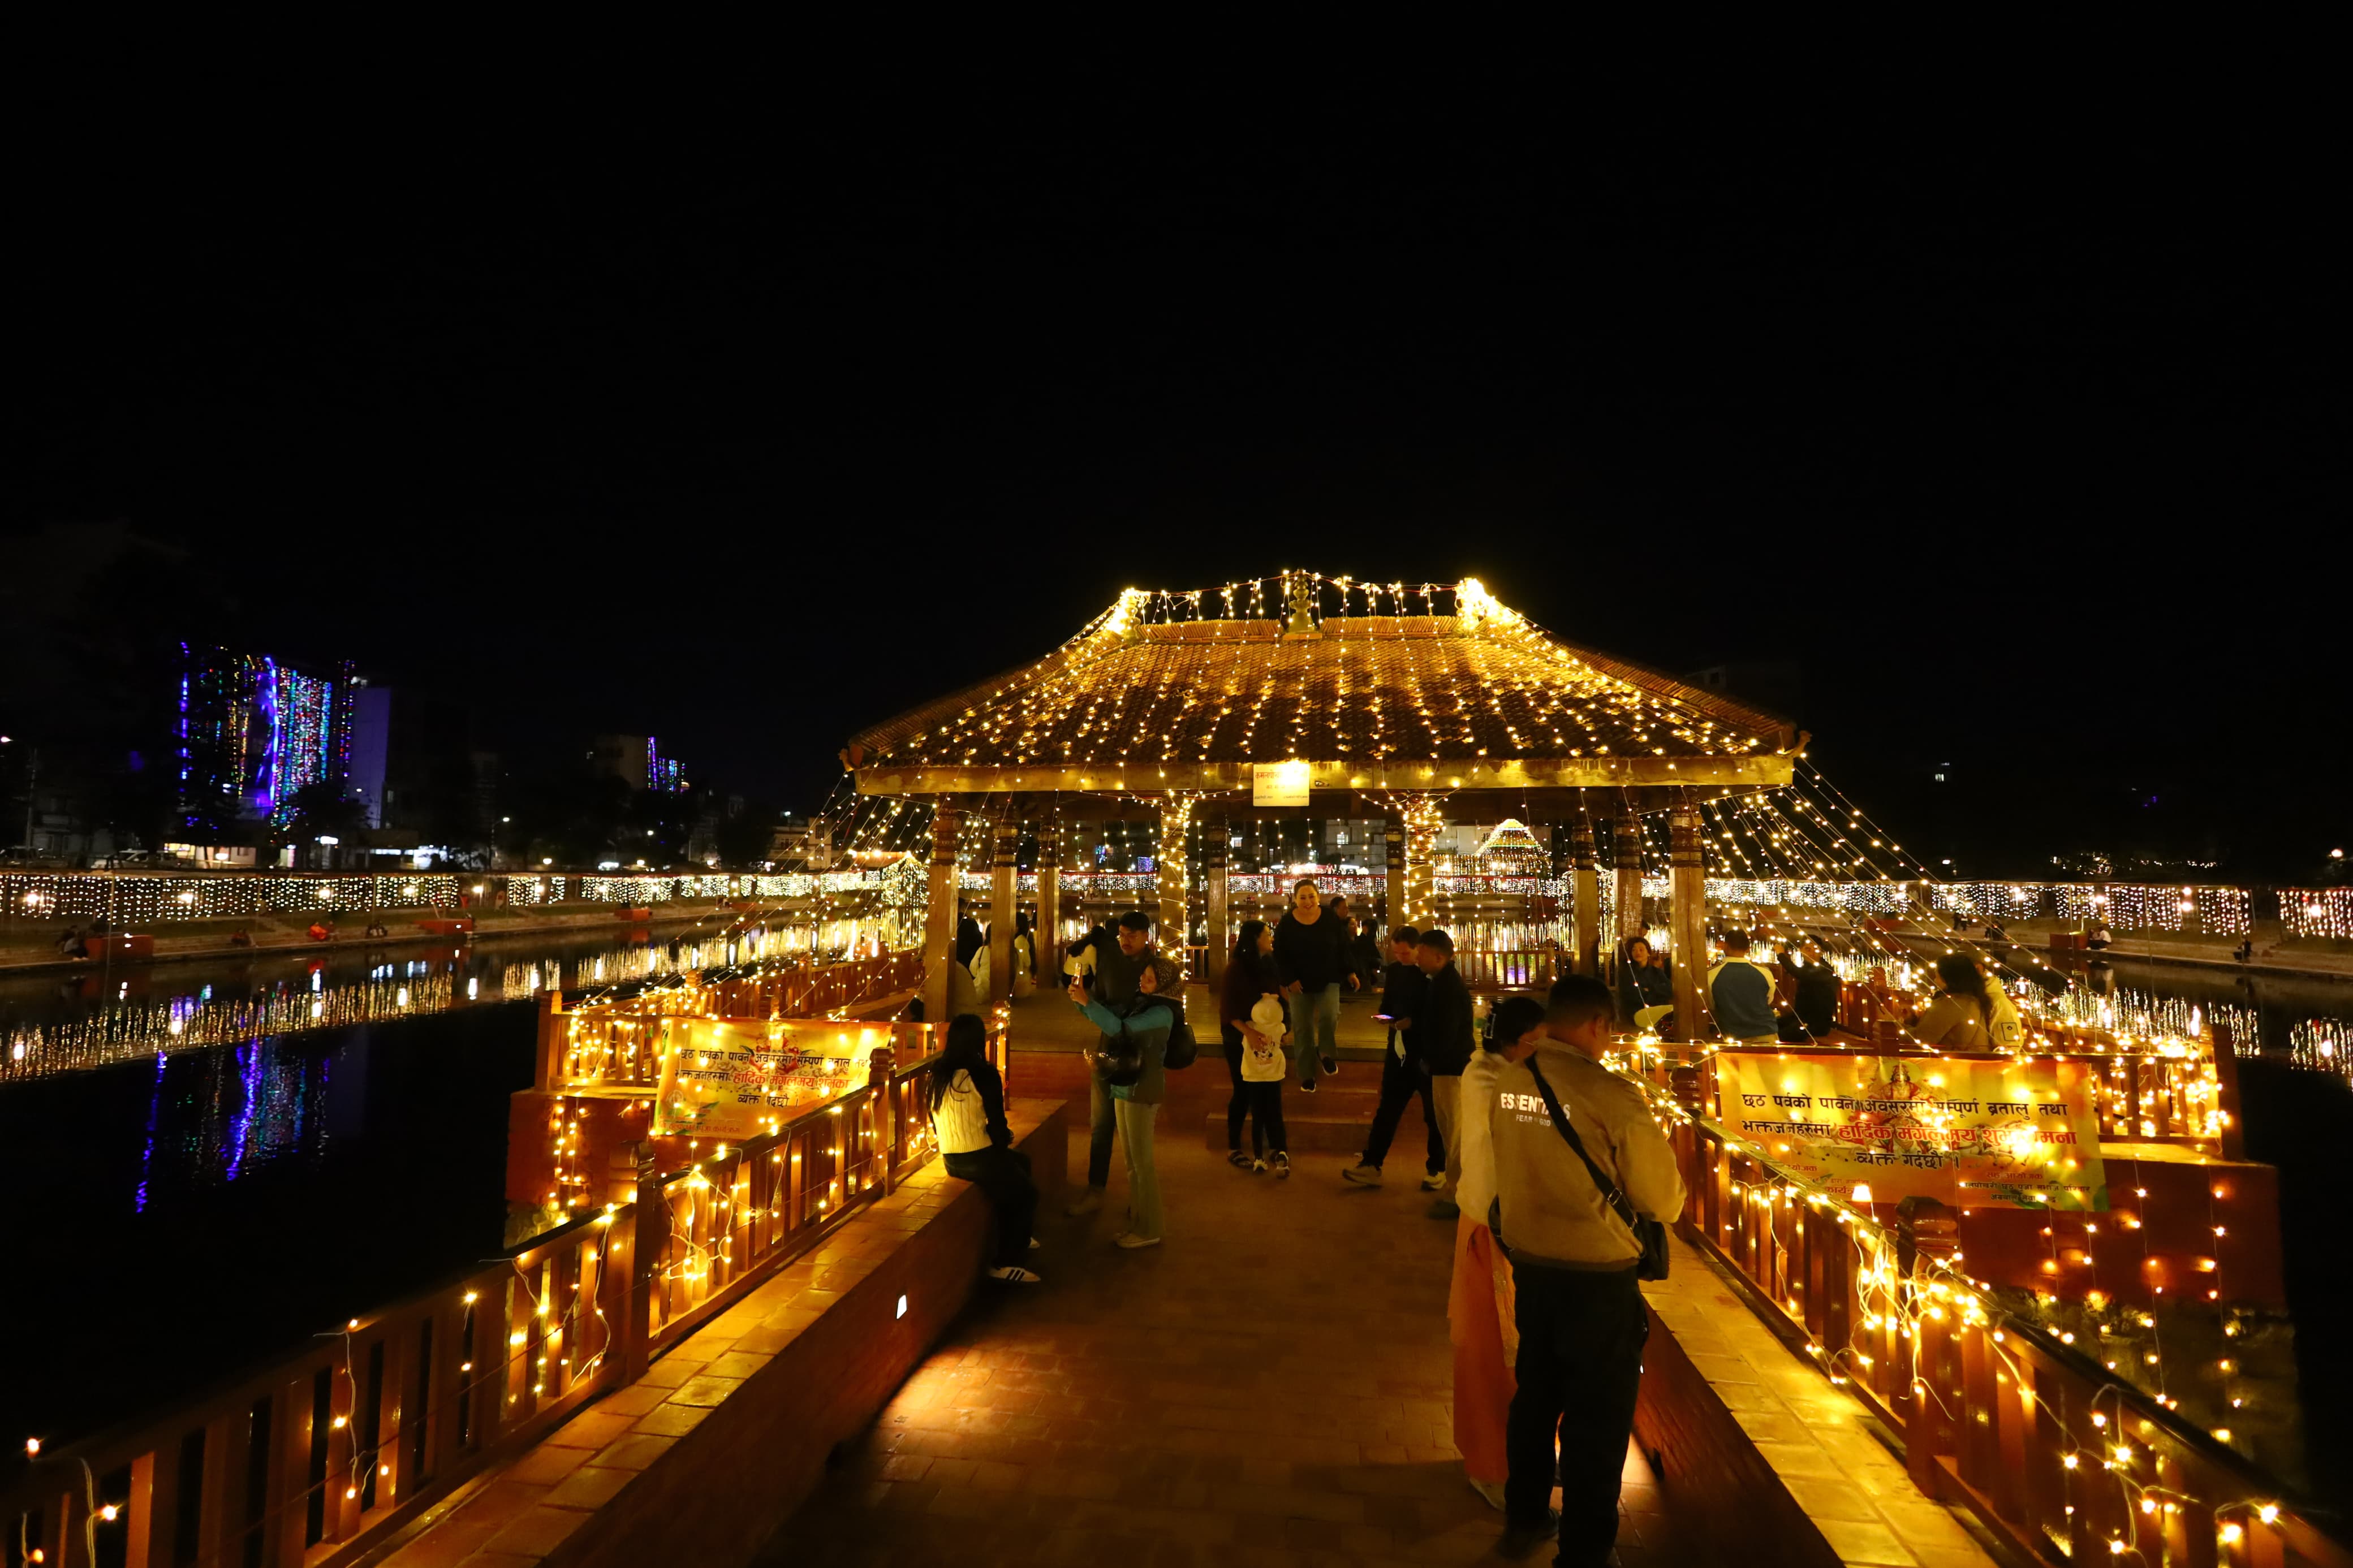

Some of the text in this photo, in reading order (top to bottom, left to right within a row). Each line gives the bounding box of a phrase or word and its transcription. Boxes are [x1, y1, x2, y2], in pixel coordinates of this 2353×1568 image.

[699, 1048, 724, 1061] पर्वको
[728, 1052, 751, 1062] पावन
[796, 1054, 824, 1069] सम्पूर्ण
[732, 1070, 765, 1085] हार्दिक
[737, 1094, 761, 1105] व्यक्त
[1500, 1092, 1571, 1120] ESSENTIS
[1742, 1094, 1766, 1108] छठ
[1772, 1092, 1812, 1109] पर्वको
[1818, 1097, 1855, 1112] पावन
[1863, 1099, 1926, 1115] अवसरमा
[2039, 1103, 2068, 1117] तथा
[1516, 1114, 1533, 1122] FEAR
[1838, 1122, 1892, 1140] हार्दिक
[1896, 1125, 1978, 1142] मंगलमय
[1856, 1152, 1895, 1167] व्यक्त
